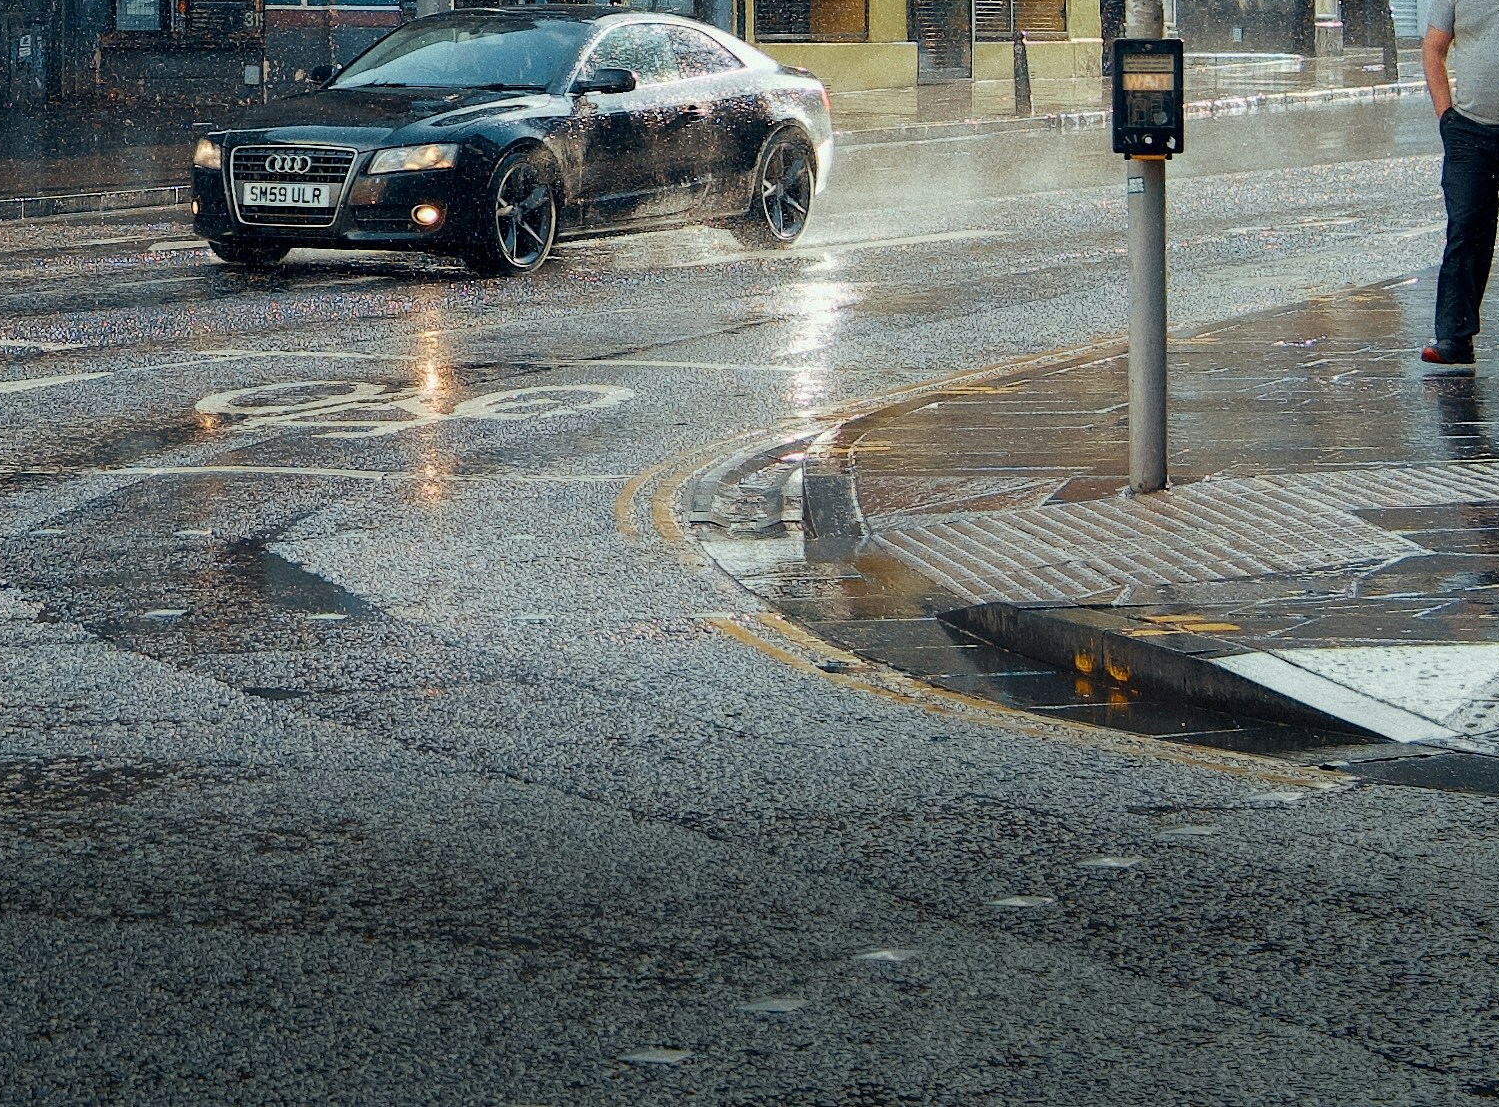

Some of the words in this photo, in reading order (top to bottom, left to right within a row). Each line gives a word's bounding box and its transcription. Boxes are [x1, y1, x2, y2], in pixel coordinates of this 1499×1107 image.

[1127, 74, 1171, 90] WAIT
[250, 185, 287, 203] SM59
[291, 187, 321, 204] ULR
